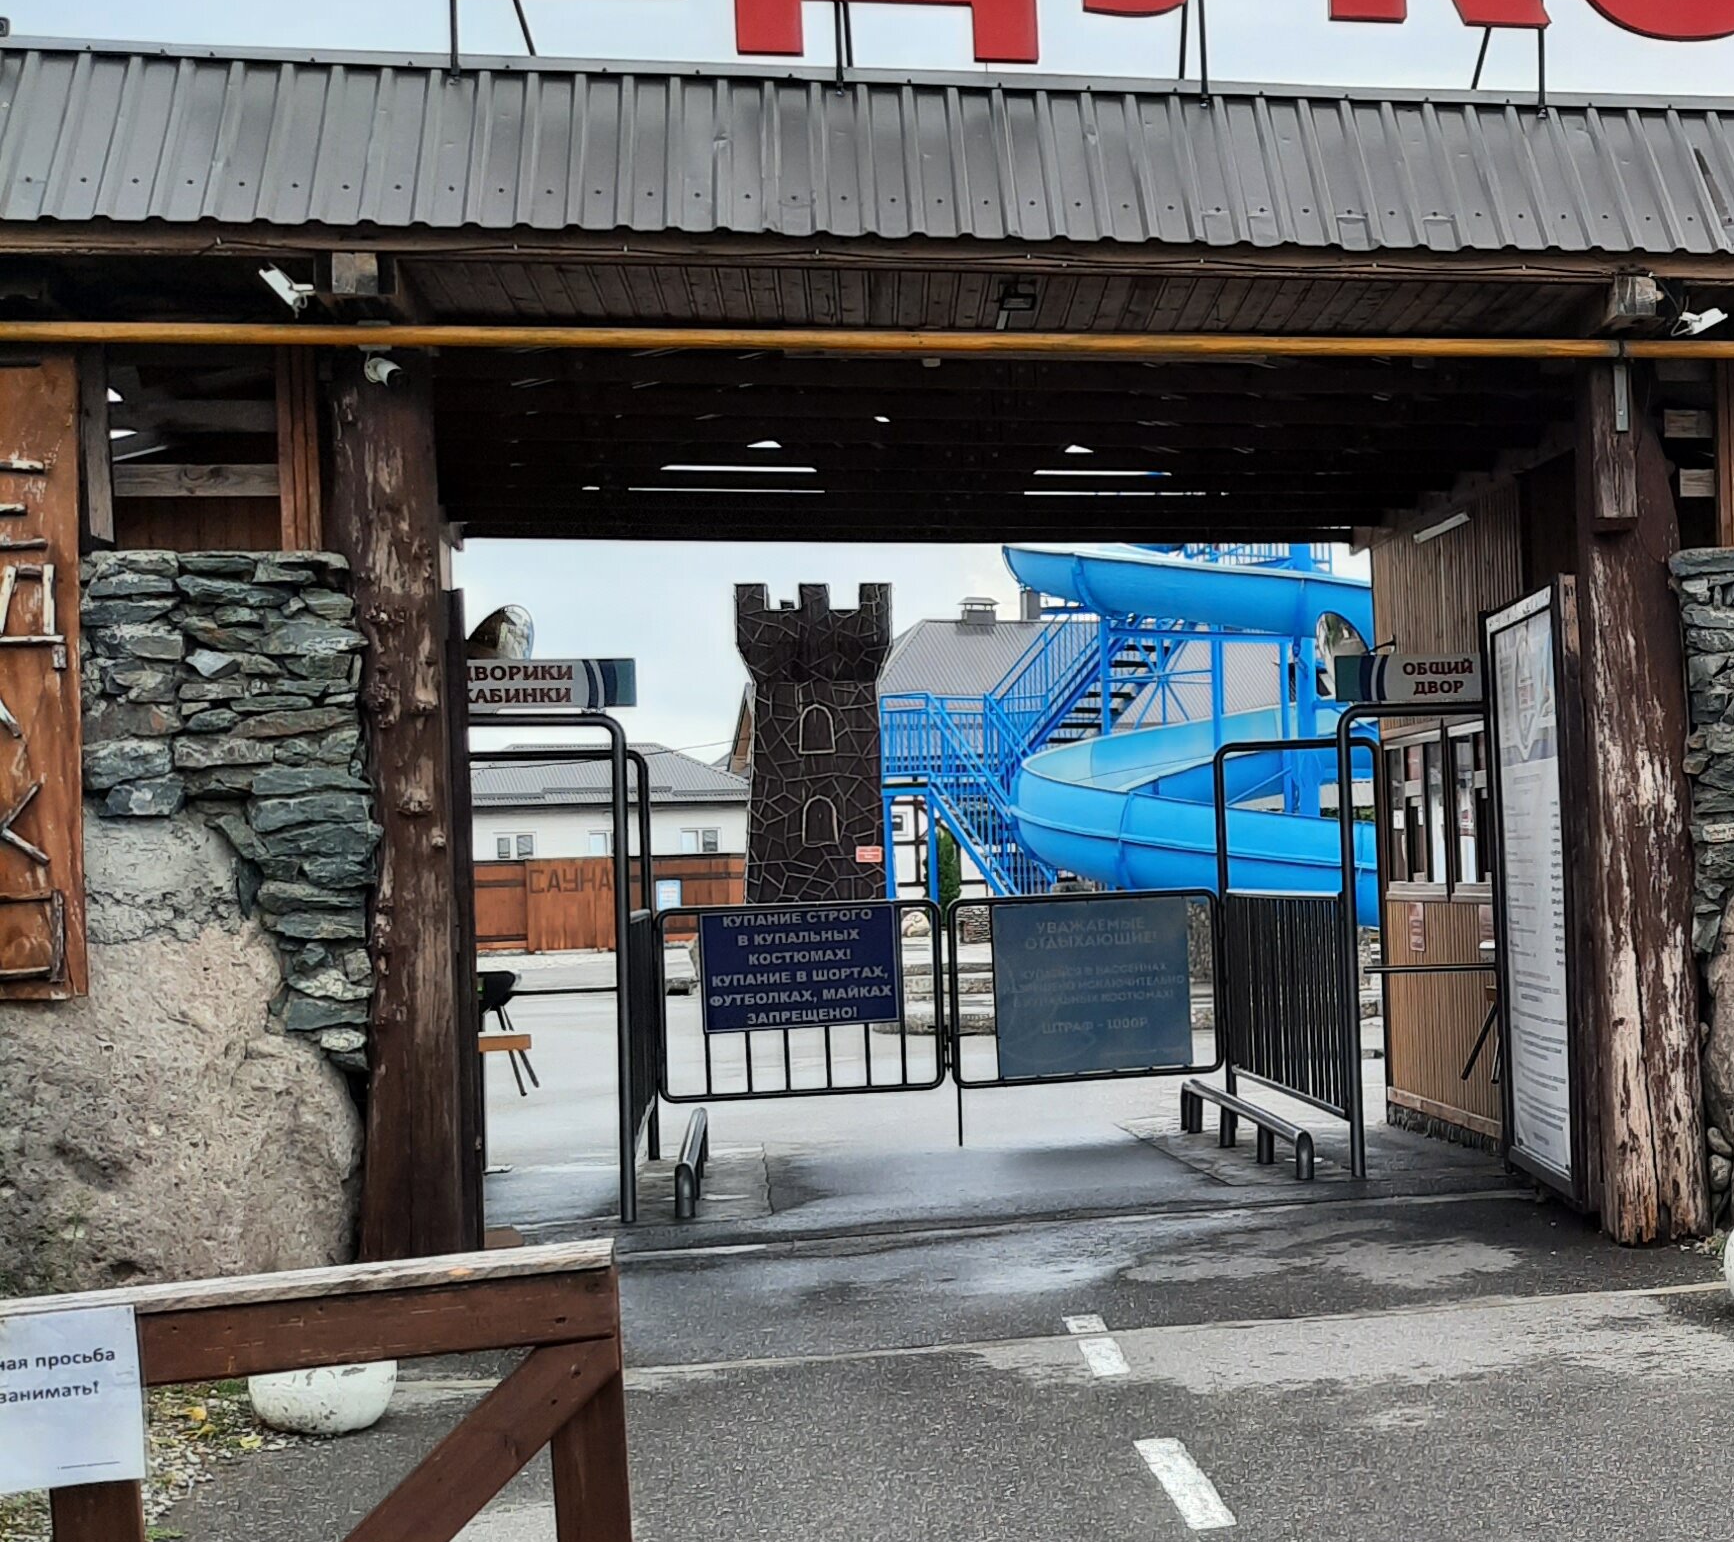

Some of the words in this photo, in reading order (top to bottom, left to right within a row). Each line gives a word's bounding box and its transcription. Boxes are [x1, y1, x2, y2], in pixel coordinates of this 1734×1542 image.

[1402, 658, 1473, 675] ОБЩИЙ
[1413, 681, 1464, 695] ДВОР
[529, 867, 612, 893] САУНА
[722, 912, 802, 927] КУПАНИЕ
[806, 908, 873, 923] СТРОГО
[1036, 916, 1145, 934] УВАЖАЕМЫЕ
[737, 935, 748, 946] В
[754, 929, 860, 945] КУПАЛЬНЫХ
[749, 949, 851, 965] КОСТЮМАХ!
[712, 971, 791, 987] КУПАНИЕ
[796, 970, 807, 982] В
[812, 965, 889, 981] ШОРТАХ,
[709, 990, 818, 1007] ФУТБОЛКАХ,
[822, 985, 893, 1000] МАЙКАХ
[747, 1006, 858, 1025] ЗАПРЕЩЕНО!
[1042, 1020, 1094, 1034] ШТРАФ
[35, 1347, 115, 1370] просьба
